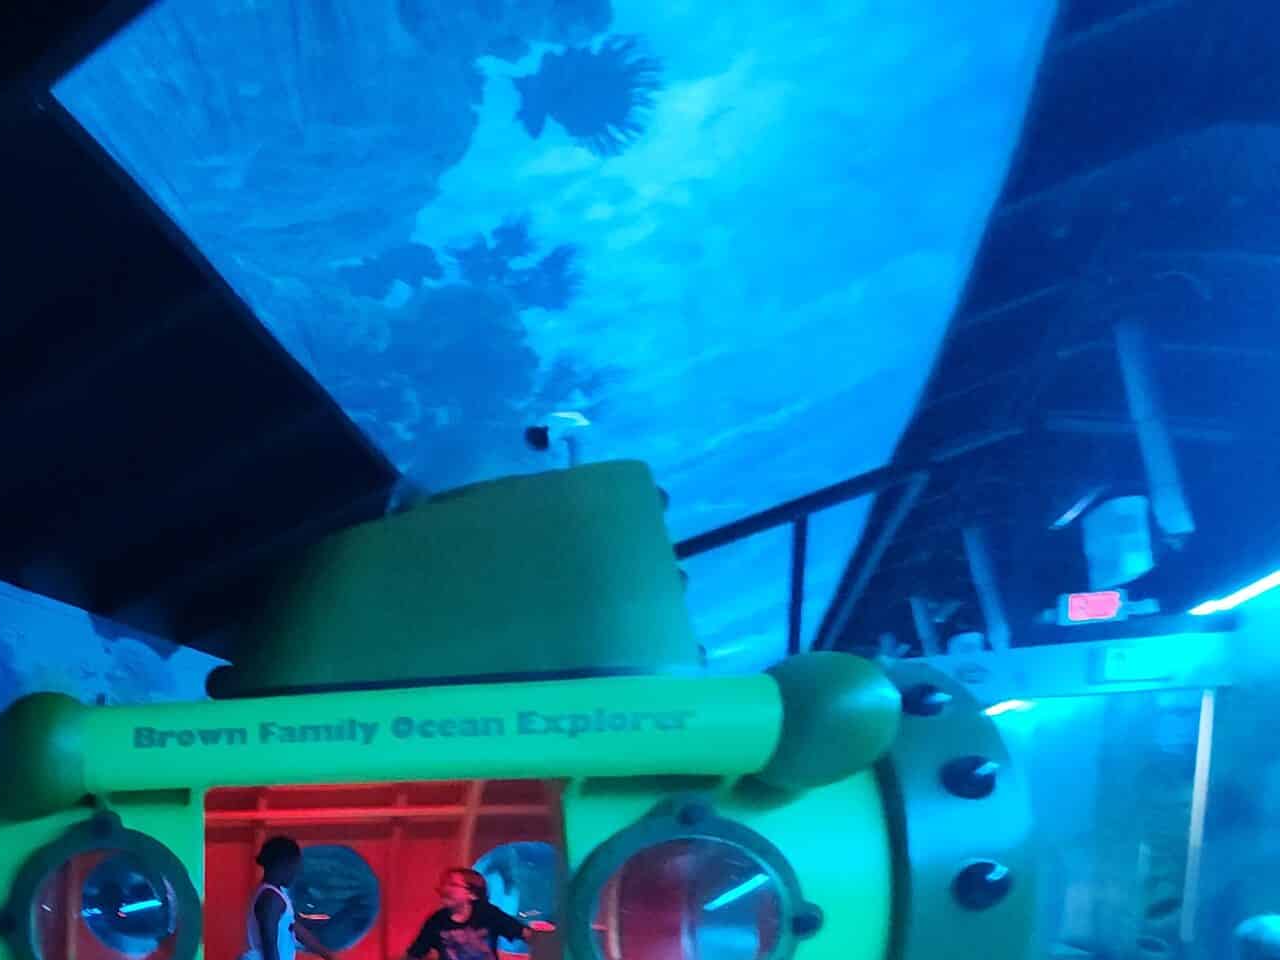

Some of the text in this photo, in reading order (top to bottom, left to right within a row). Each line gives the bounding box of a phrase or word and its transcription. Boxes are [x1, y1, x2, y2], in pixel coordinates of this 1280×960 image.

[134, 707, 696, 748] Brown Family Ocean Explorer
